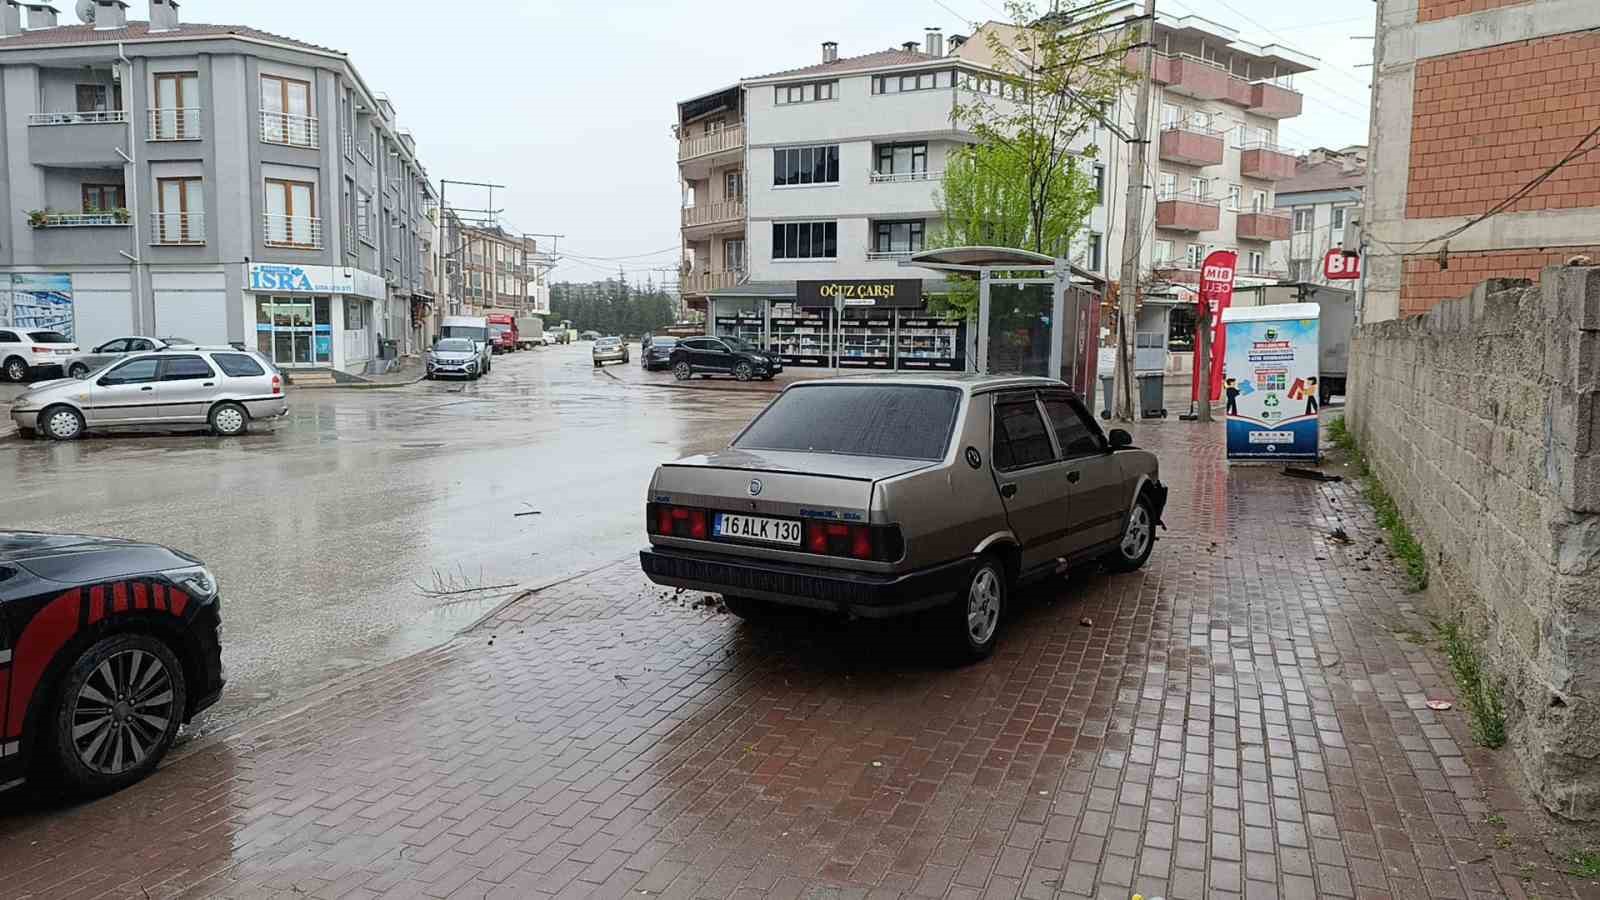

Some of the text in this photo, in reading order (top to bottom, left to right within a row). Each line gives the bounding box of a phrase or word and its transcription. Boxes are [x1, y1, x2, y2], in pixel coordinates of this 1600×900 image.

[820, 284, 895, 298] OĞUZ ÇARŞI
[724, 516, 800, 541] 16 ALK 130
